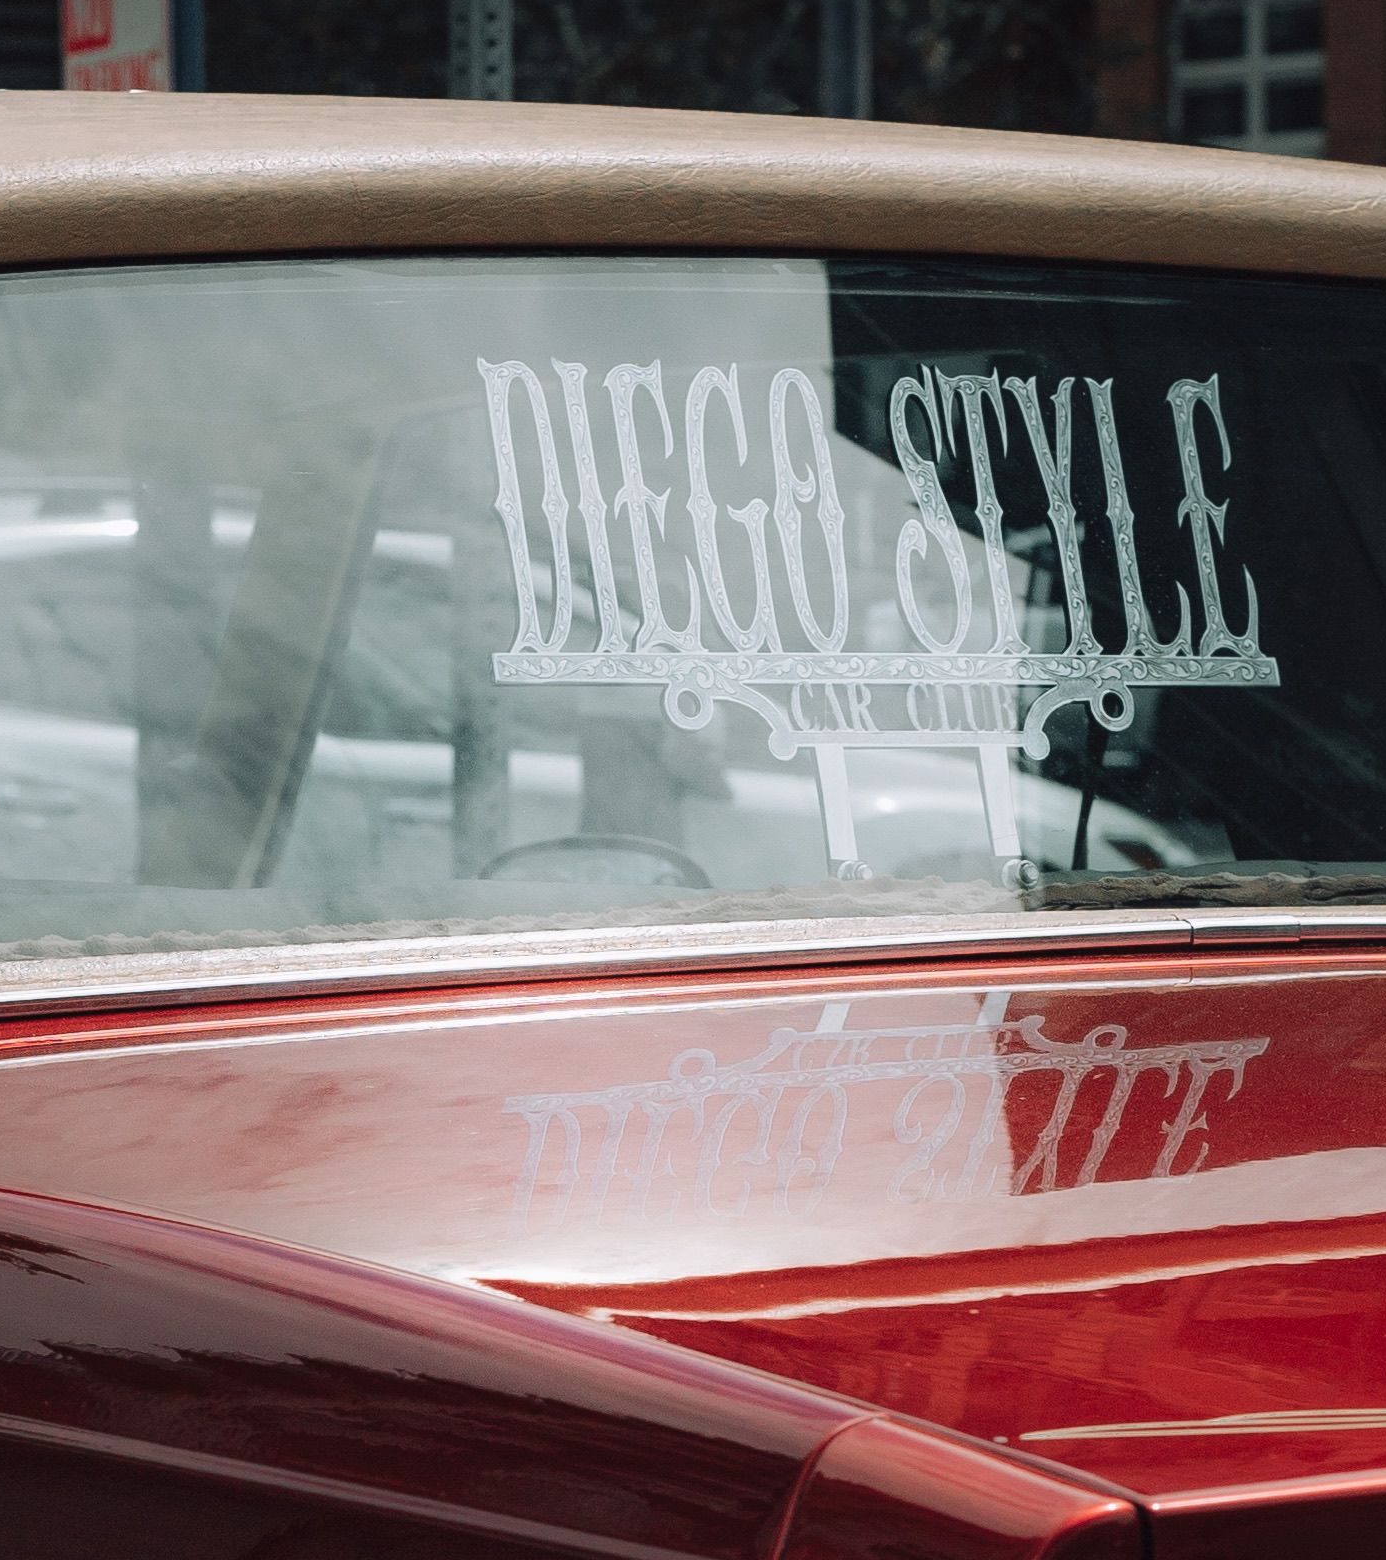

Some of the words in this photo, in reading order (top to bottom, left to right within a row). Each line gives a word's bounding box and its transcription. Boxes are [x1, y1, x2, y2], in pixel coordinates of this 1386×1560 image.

[477, 357, 849, 653] DIEGO
[890, 364, 1269, 658] STYLE
[791, 681, 880, 731] CAR
[906, 681, 1017, 732] CLUB
